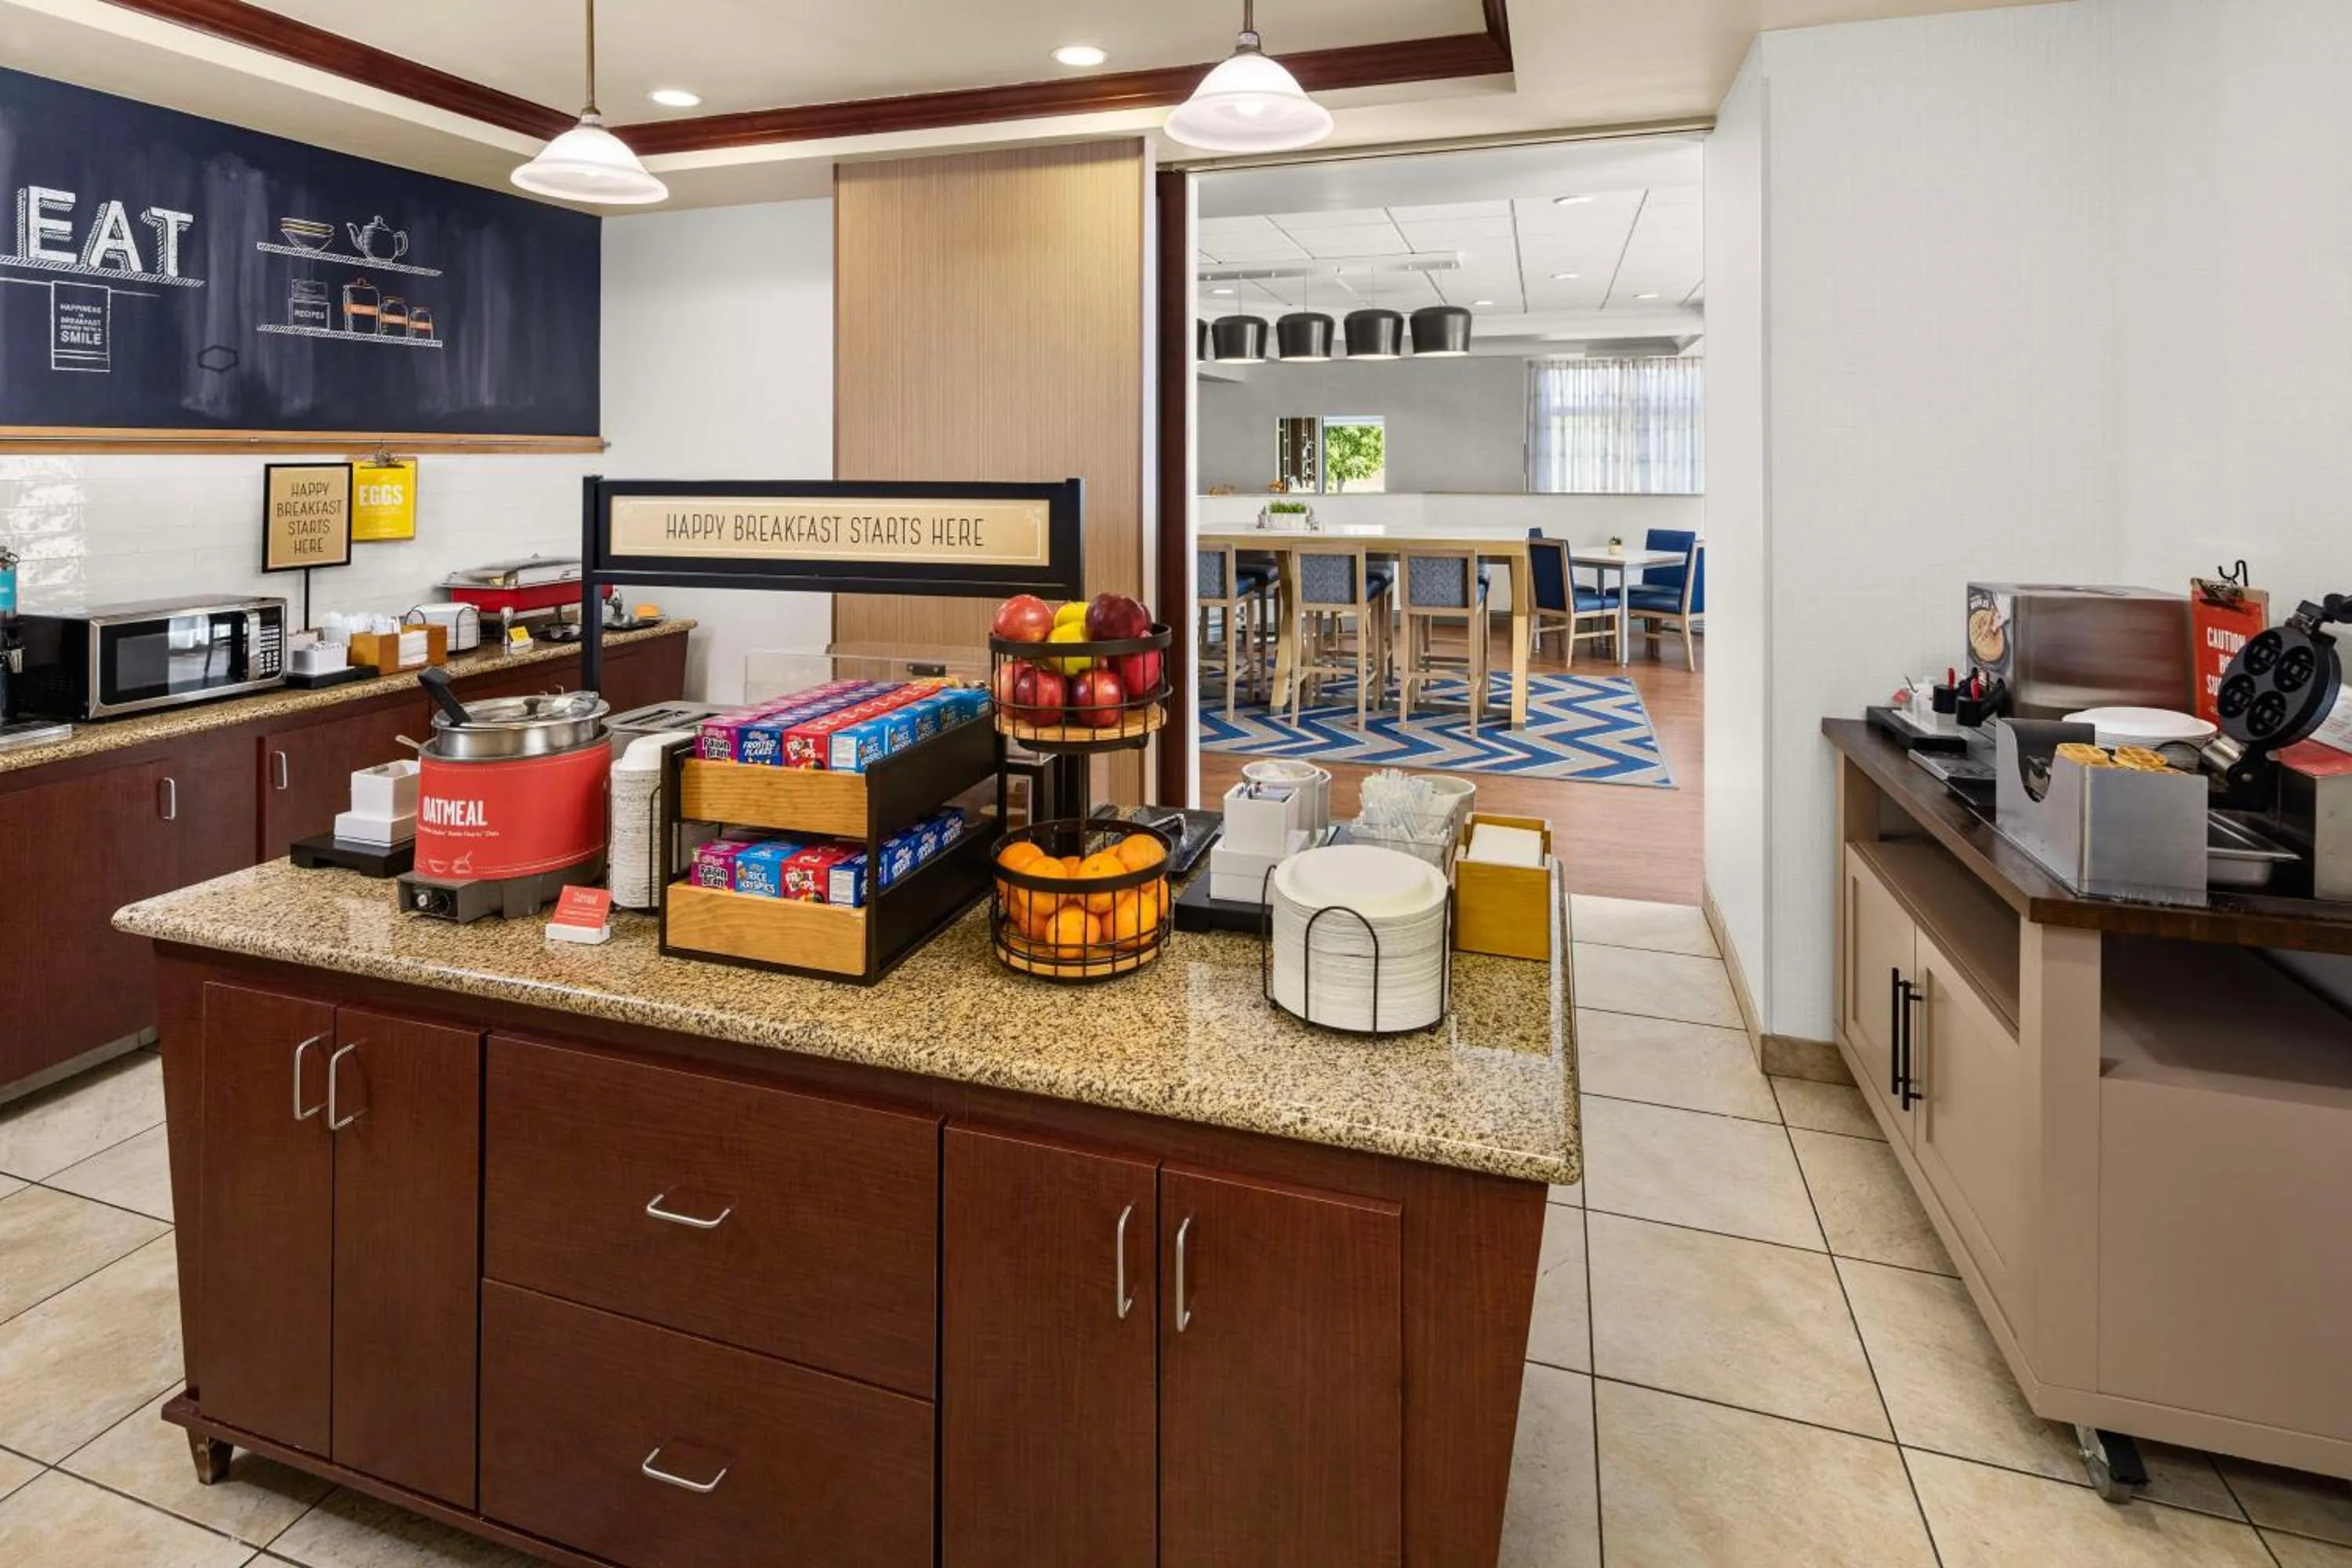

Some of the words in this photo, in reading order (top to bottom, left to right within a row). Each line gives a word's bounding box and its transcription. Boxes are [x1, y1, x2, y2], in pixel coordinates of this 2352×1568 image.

[17, 185, 194, 277] EAT
[295, 310, 325, 319] RECIPES
[61, 330, 101, 345] SMILE
[291, 482, 329, 497] HAPPY
[358, 485, 403, 506] EGGS
[277, 499, 342, 517] BREAKFAST
[288, 519, 330, 535] STARTS
[666, 514, 725, 539] HAPPY
[734, 514, 841, 543] BREAKFAST
[850, 517, 921, 545] STARTS
[931, 517, 985, 546] HERE
[294, 538, 324, 555] HERE
[423, 796, 488, 826] OATMEAL
[747, 871, 767, 883] RICE
